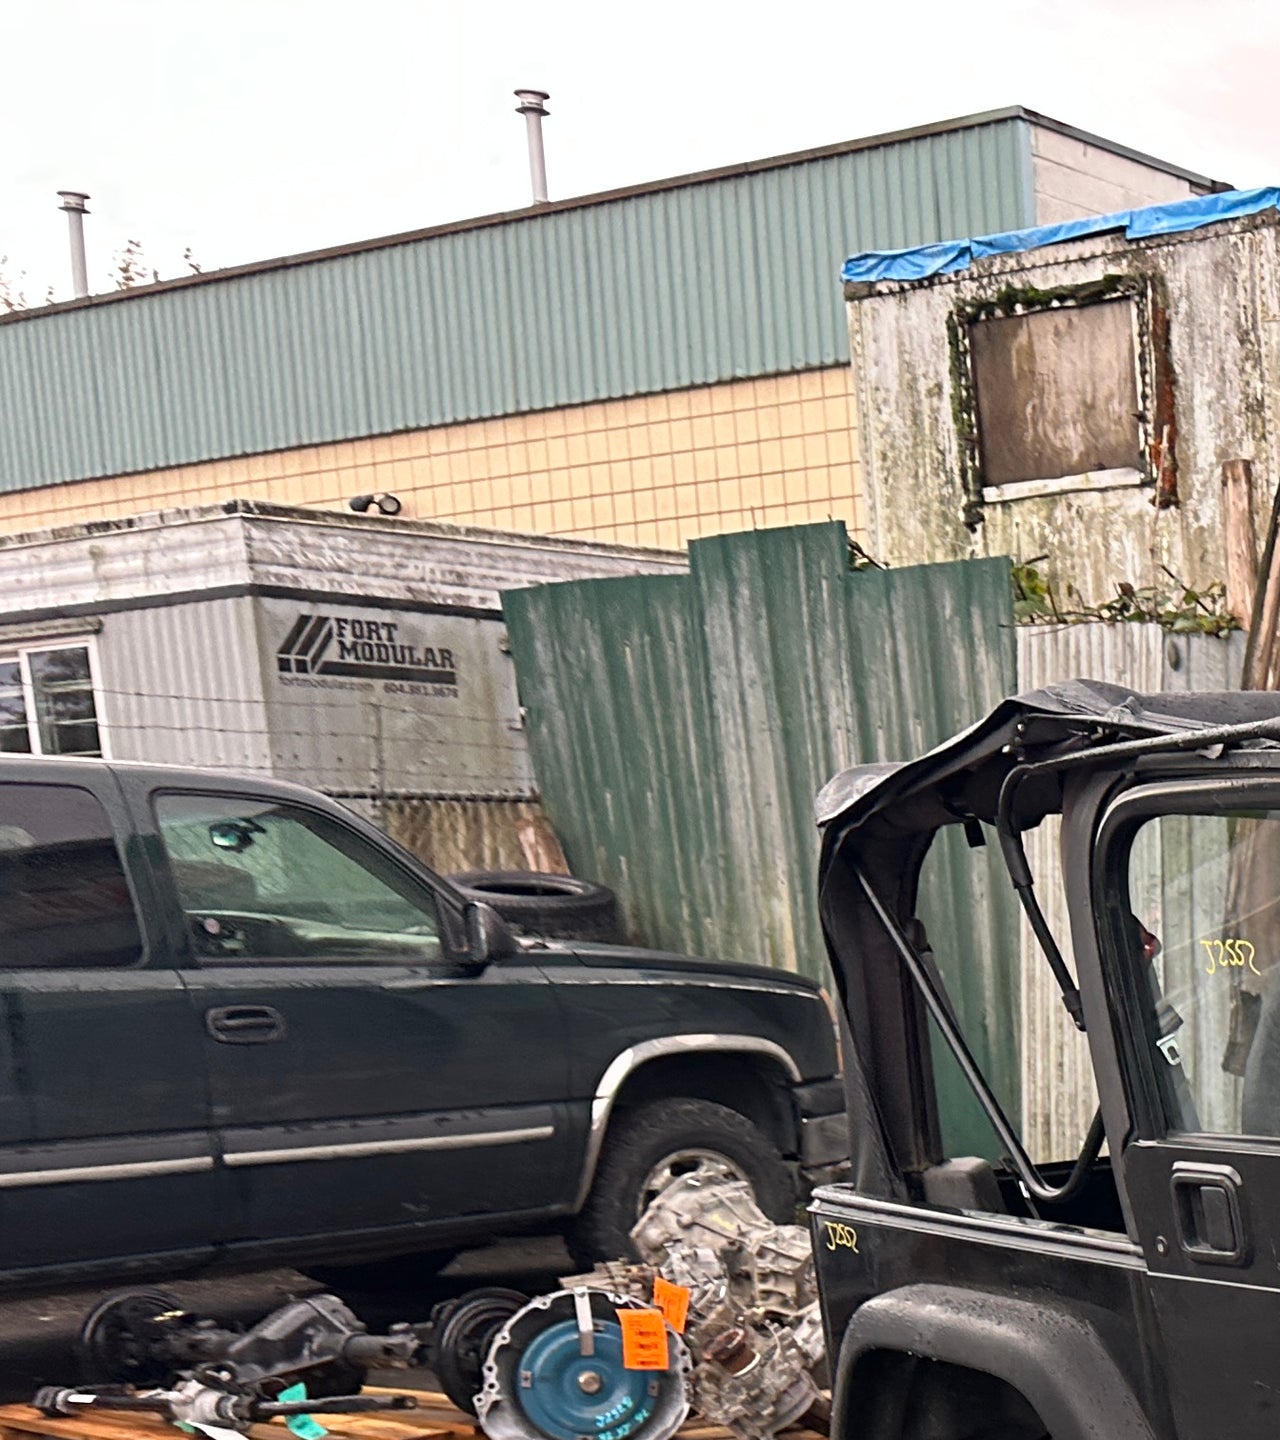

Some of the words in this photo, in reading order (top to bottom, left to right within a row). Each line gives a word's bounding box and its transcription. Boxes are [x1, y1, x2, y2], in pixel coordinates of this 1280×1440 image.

[335, 617, 398, 643] FORT
[337, 639, 455, 669] MODULAR
[1199, 938, 1262, 976] J2552
